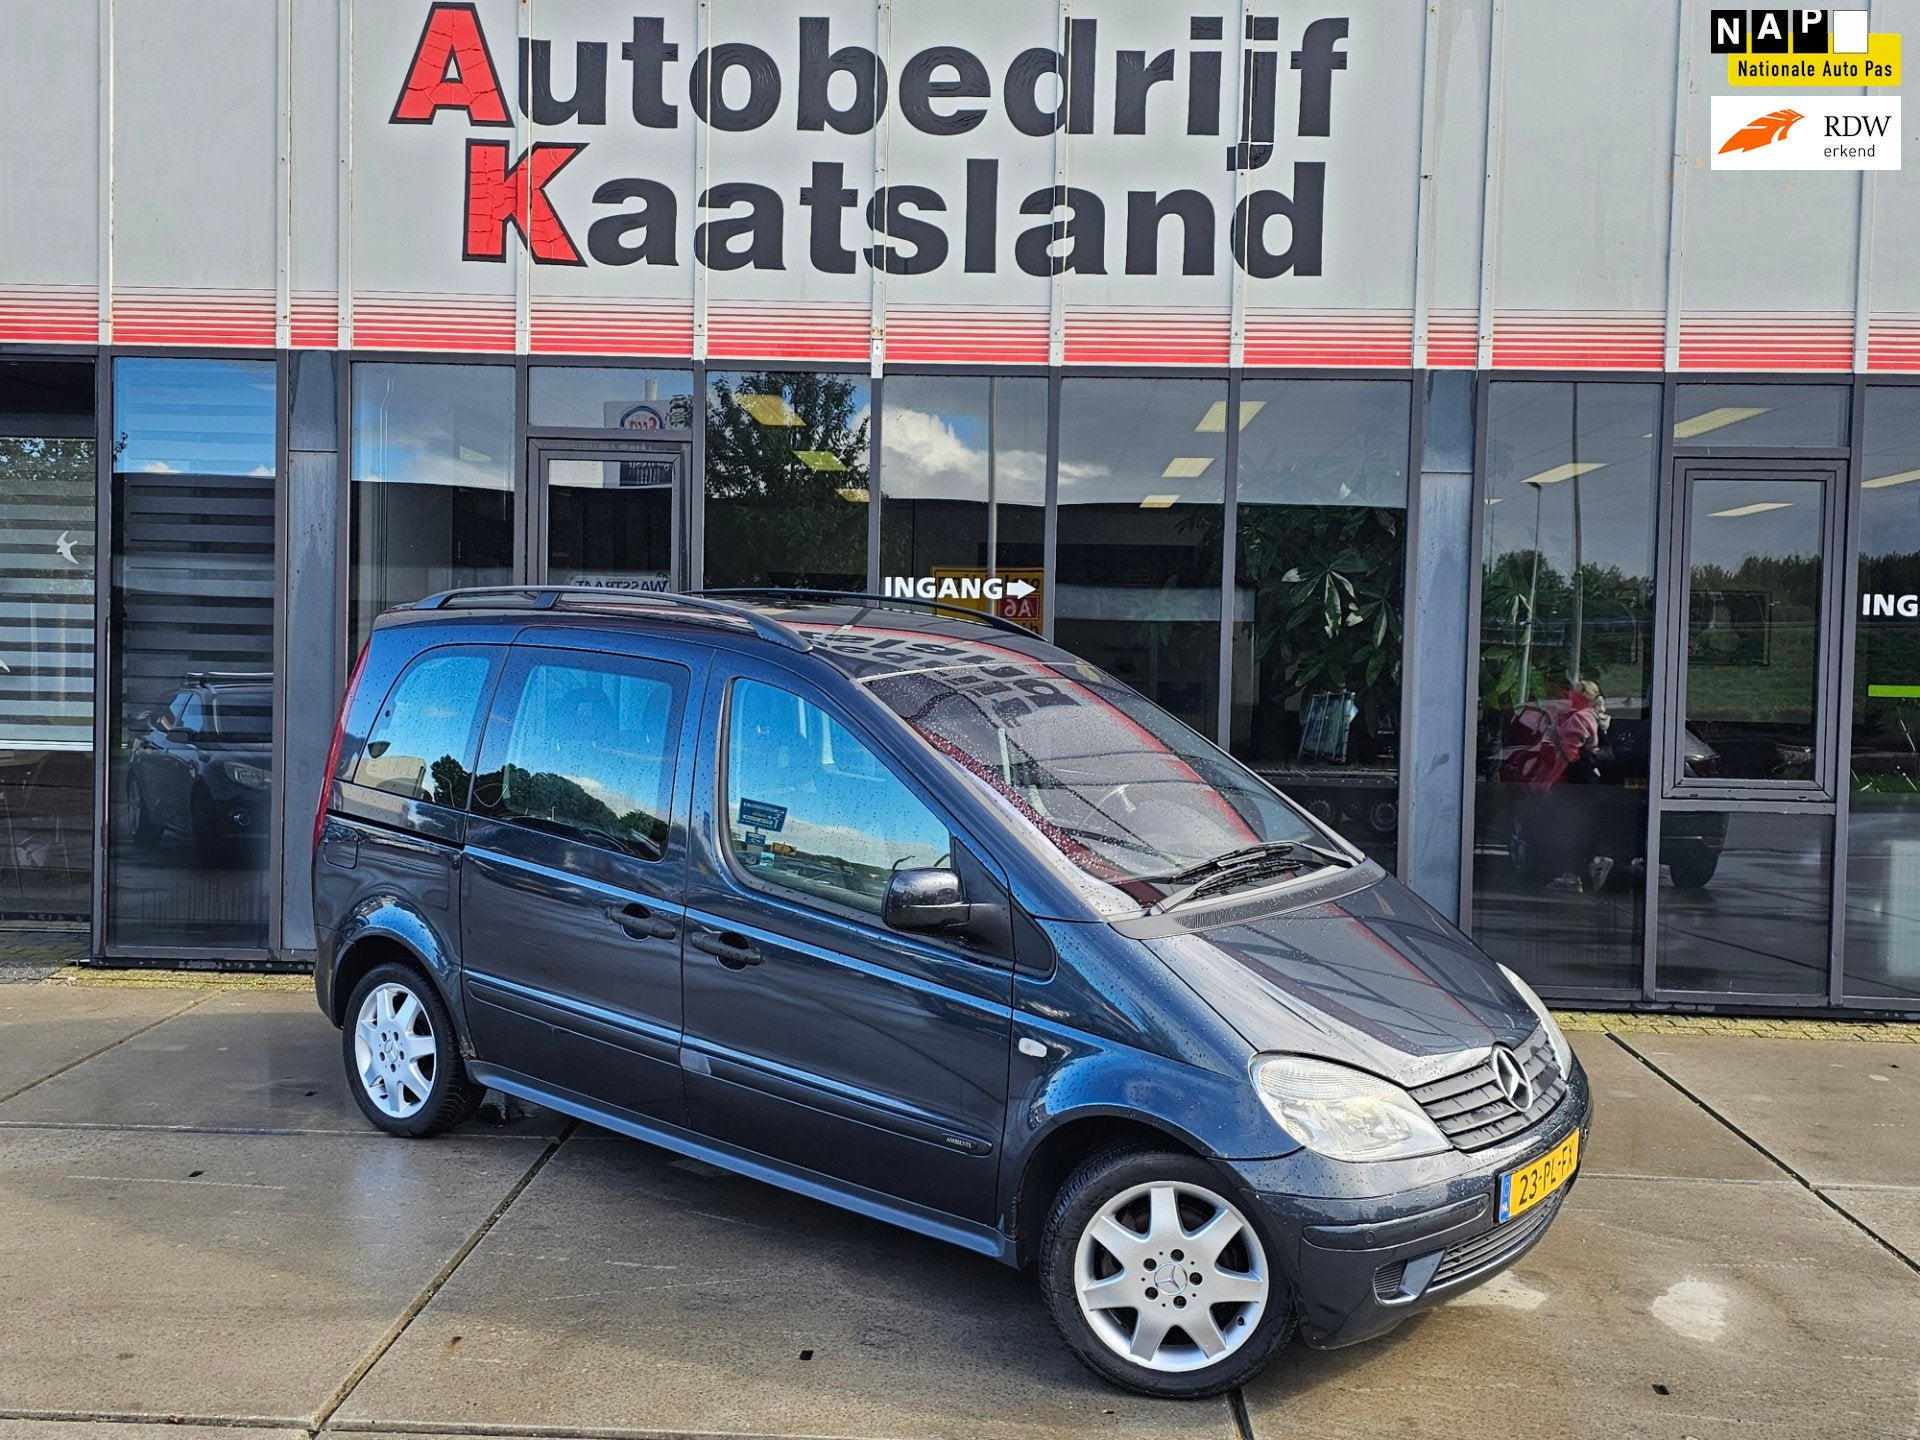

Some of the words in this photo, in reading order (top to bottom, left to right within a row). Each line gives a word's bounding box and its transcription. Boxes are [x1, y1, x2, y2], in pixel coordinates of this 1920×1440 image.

[389, 1, 1348, 171] Autobedrijf
[462, 137, 1326, 278] Kaatsland
[884, 576, 1003, 600] INGANG
